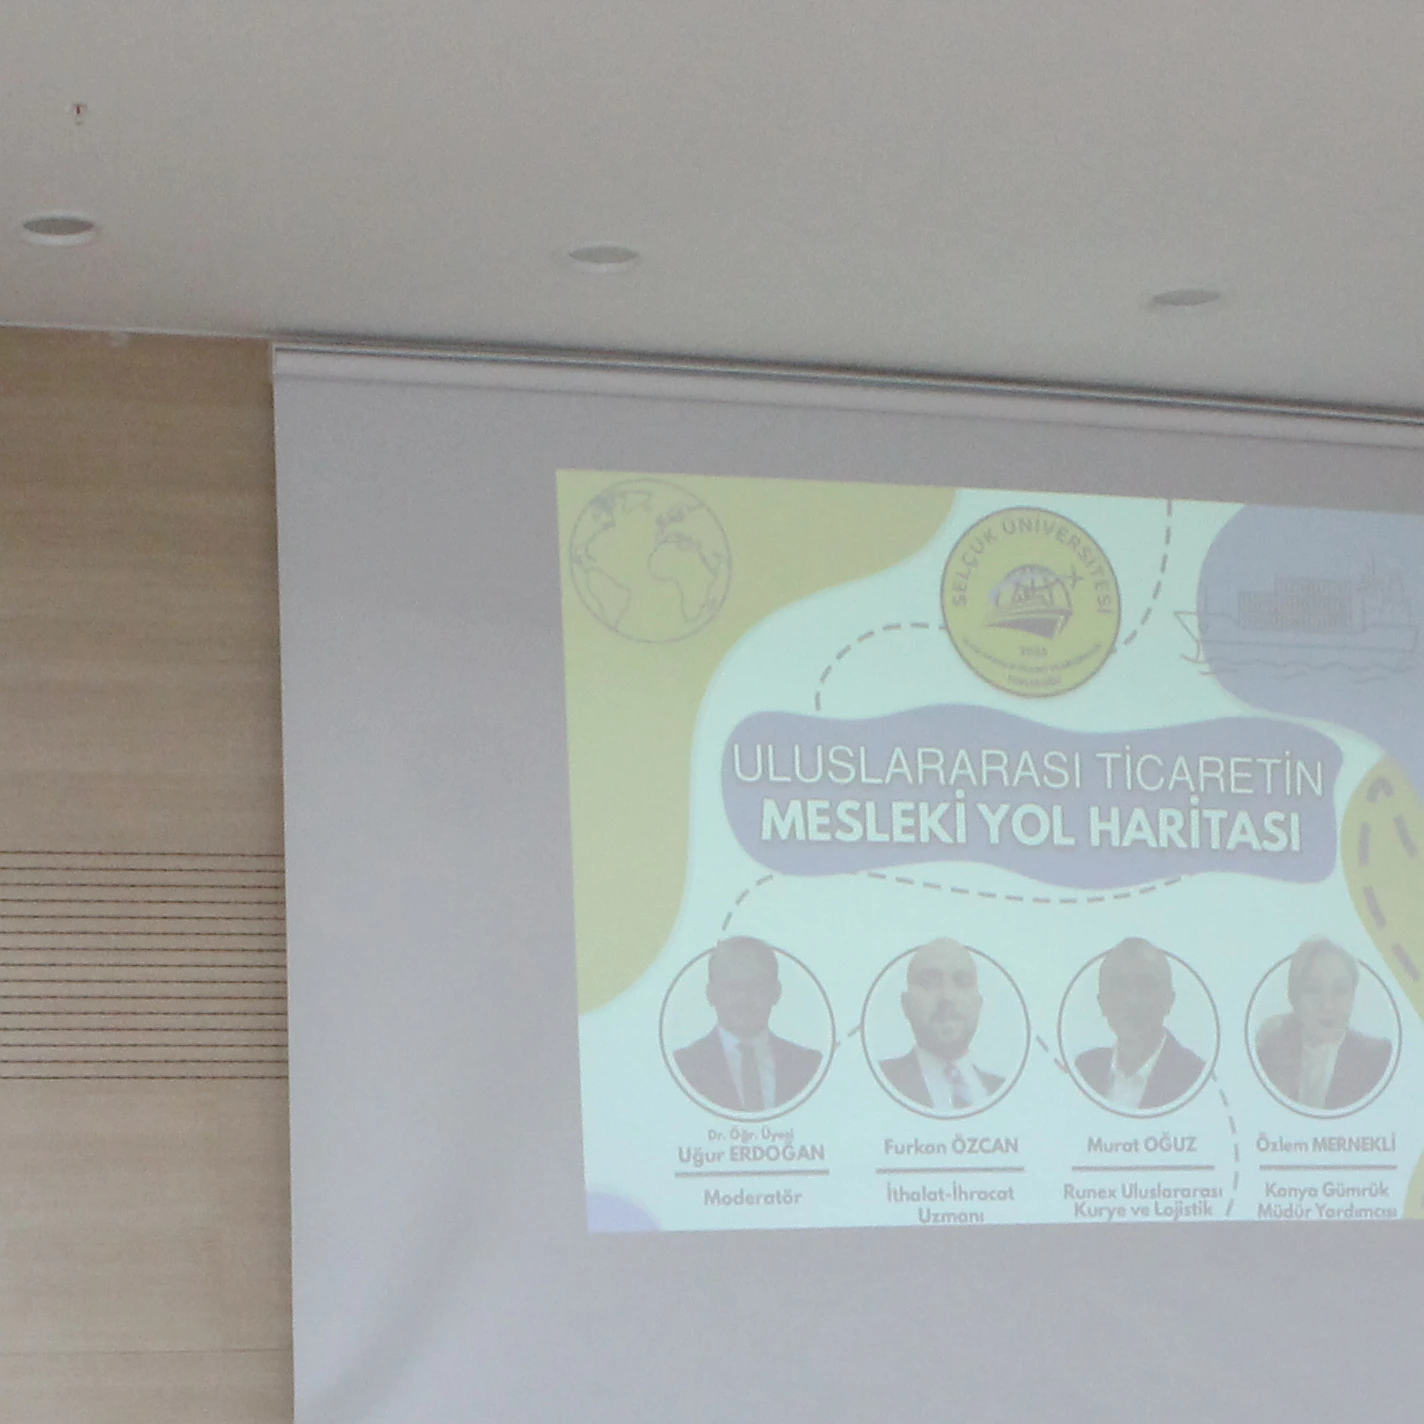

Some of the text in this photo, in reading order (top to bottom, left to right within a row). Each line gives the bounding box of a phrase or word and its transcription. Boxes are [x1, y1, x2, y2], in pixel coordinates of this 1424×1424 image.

[733, 743, 1324, 797] ULUSLARARASI TİCARETİN
[761, 788, 1302, 852] MESLEKİ YOL HARİTASI
[707, 1128, 726, 1140] Dr.
[884, 1133, 1018, 1155] Furkan ÖZCAN
[1087, 1131, 1198, 1153] Murat OĞUZ
[1256, 1132, 1396, 1152] Özlem MERNEKLİ
[678, 1141, 826, 1167] Uğur ERDOĞAN
[703, 1188, 802, 1206] Moderatör
[886, 1180, 1015, 1203] İthalat-İhracat
[1063, 1182, 1223, 1200] Runex Uluslararası
[1322, 1181, 1389, 1198] Gümrük
[918, 1207, 984, 1224] Uzmanı
[1075, 1200, 1213, 1222] Kurye ve Lojistik
[1257, 1203, 1311, 1219] Müdür
